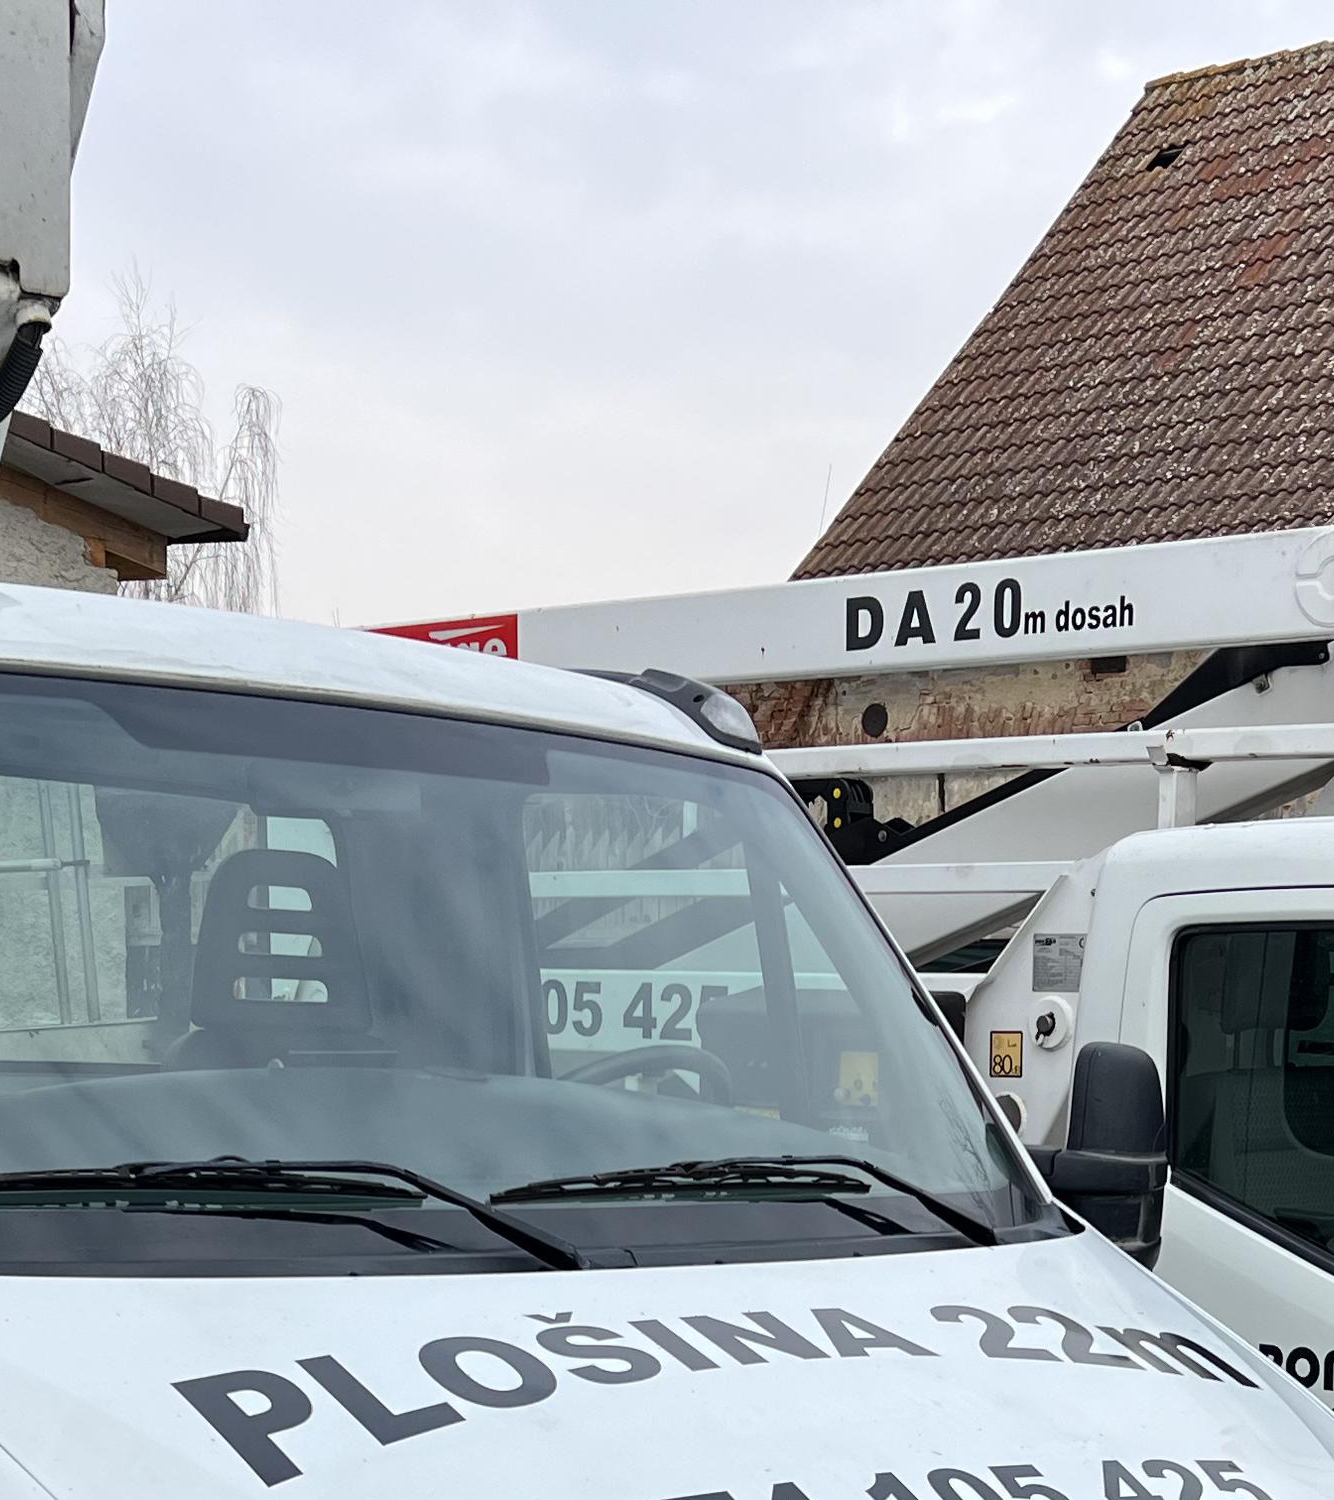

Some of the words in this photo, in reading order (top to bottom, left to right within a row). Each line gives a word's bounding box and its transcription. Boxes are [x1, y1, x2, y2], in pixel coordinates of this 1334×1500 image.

[845, 590, 936, 651] DA
[1055, 595, 1134, 632] dosah
[993, 1054, 1013, 1075] 80
[170, 1308, 940, 1487] PLOŠINA
[932, 1305, 1262, 1388] 22m
